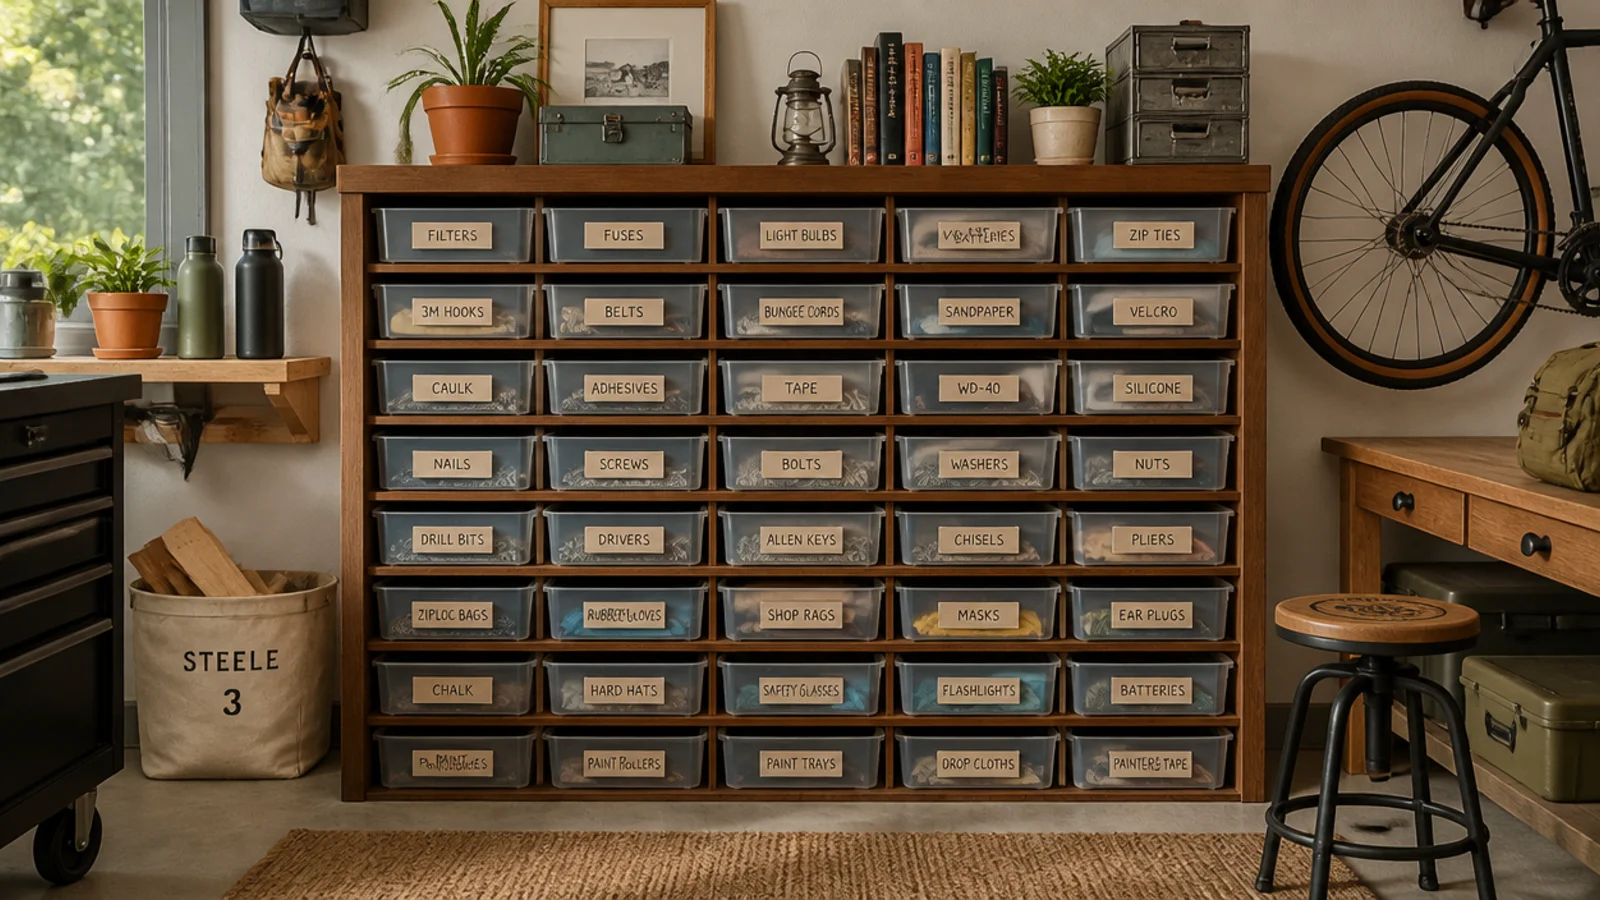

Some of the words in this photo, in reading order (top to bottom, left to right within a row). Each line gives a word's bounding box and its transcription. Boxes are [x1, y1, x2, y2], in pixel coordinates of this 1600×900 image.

[428, 229, 478, 242] FILTERS
[604, 229, 644, 242] FUSES
[766, 229, 799, 242] LIGHT
[801, 228, 837, 242] BULBS
[1129, 228, 1149, 242] ZIP
[1153, 228, 1181, 242] TIES
[421, 304, 440, 319] 3M
[443, 304, 485, 319] HOOKS
[604, 305, 644, 319] BELTS
[764, 304, 805, 319] BUNGEE
[807, 305, 840, 319] CORDS
[945, 305, 1015, 318] SANDPAPER
[1129, 305, 1178, 318] VELCRO
[431, 381, 474, 395] CAULK
[591, 381, 658, 395] ADHESIVES
[784, 381, 819, 395] TAPE
[957, 381, 1002, 395] WD-40
[1125, 381, 1182, 395] SILICONE
[433, 458, 471, 471] NAILS
[599, 458, 649, 471] SCREWS
[781, 458, 822, 471] BOLTS
[950, 458, 1009, 471] WASHERS
[1135, 458, 1171, 471] NUTS
[421, 533, 454, 546] DRILL
[457, 532, 485, 546] BITS
[598, 533, 651, 547] DRIVERS
[766, 533, 803, 546] ALLEN
[807, 533, 837, 546] KEYS
[954, 533, 1005, 547] CHISELS
[1131, 533, 1175, 547] PLIERS
[418, 608, 456, 622] ZIPLOC
[458, 608, 489, 622] BAGS
[767, 608, 800, 622] SHOP
[803, 608, 836, 622] RAGS
[957, 608, 1001, 621] MASKS
[1119, 608, 1144, 621] EAR
[1147, 608, 1186, 622] PLUGS
[182, 648, 280, 672] STEELE
[432, 683, 474, 697] CHALK
[590, 684, 623, 697] HARD
[626, 684, 658, 697] HATS
[942, 684, 1016, 697] FLASHLIGHTS
[1120, 684, 1186, 697] BATTERIES
[222, 688, 243, 716] 3
[587, 756, 617, 770] PAINT
[766, 757, 799, 770] PAINT
[801, 757, 836, 770] TRAYS
[942, 757, 971, 770] DROP
[973, 757, 1015, 771] CLOTHS
[1163, 757, 1188, 771] TAPE
